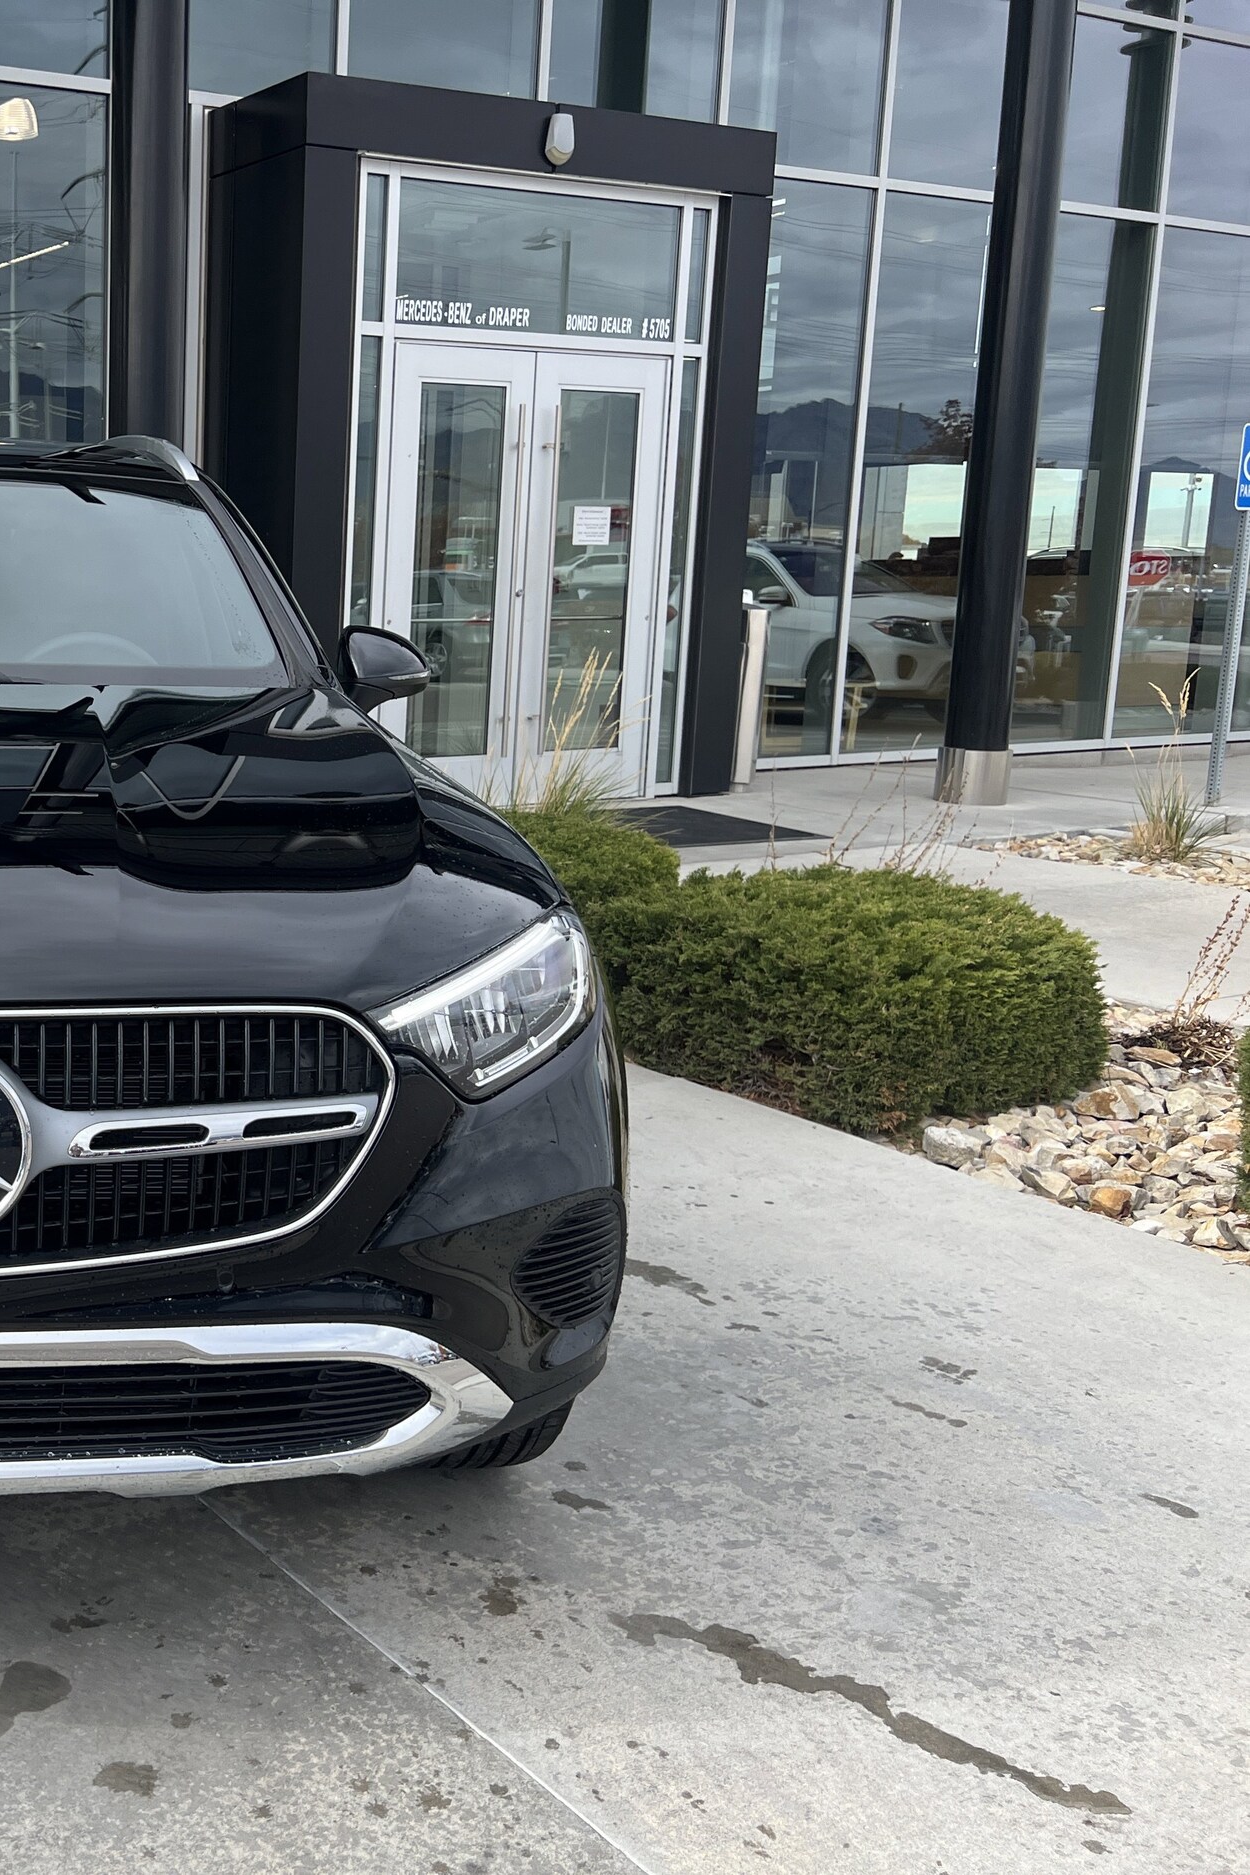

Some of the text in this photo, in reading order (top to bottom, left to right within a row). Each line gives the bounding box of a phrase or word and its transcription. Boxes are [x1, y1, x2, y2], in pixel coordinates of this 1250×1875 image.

[475, 313, 487, 325] of
[488, 306, 530, 327] DRAPER
[565, 314, 599, 332] BONDED
[600, 316, 633, 334] DEALER
